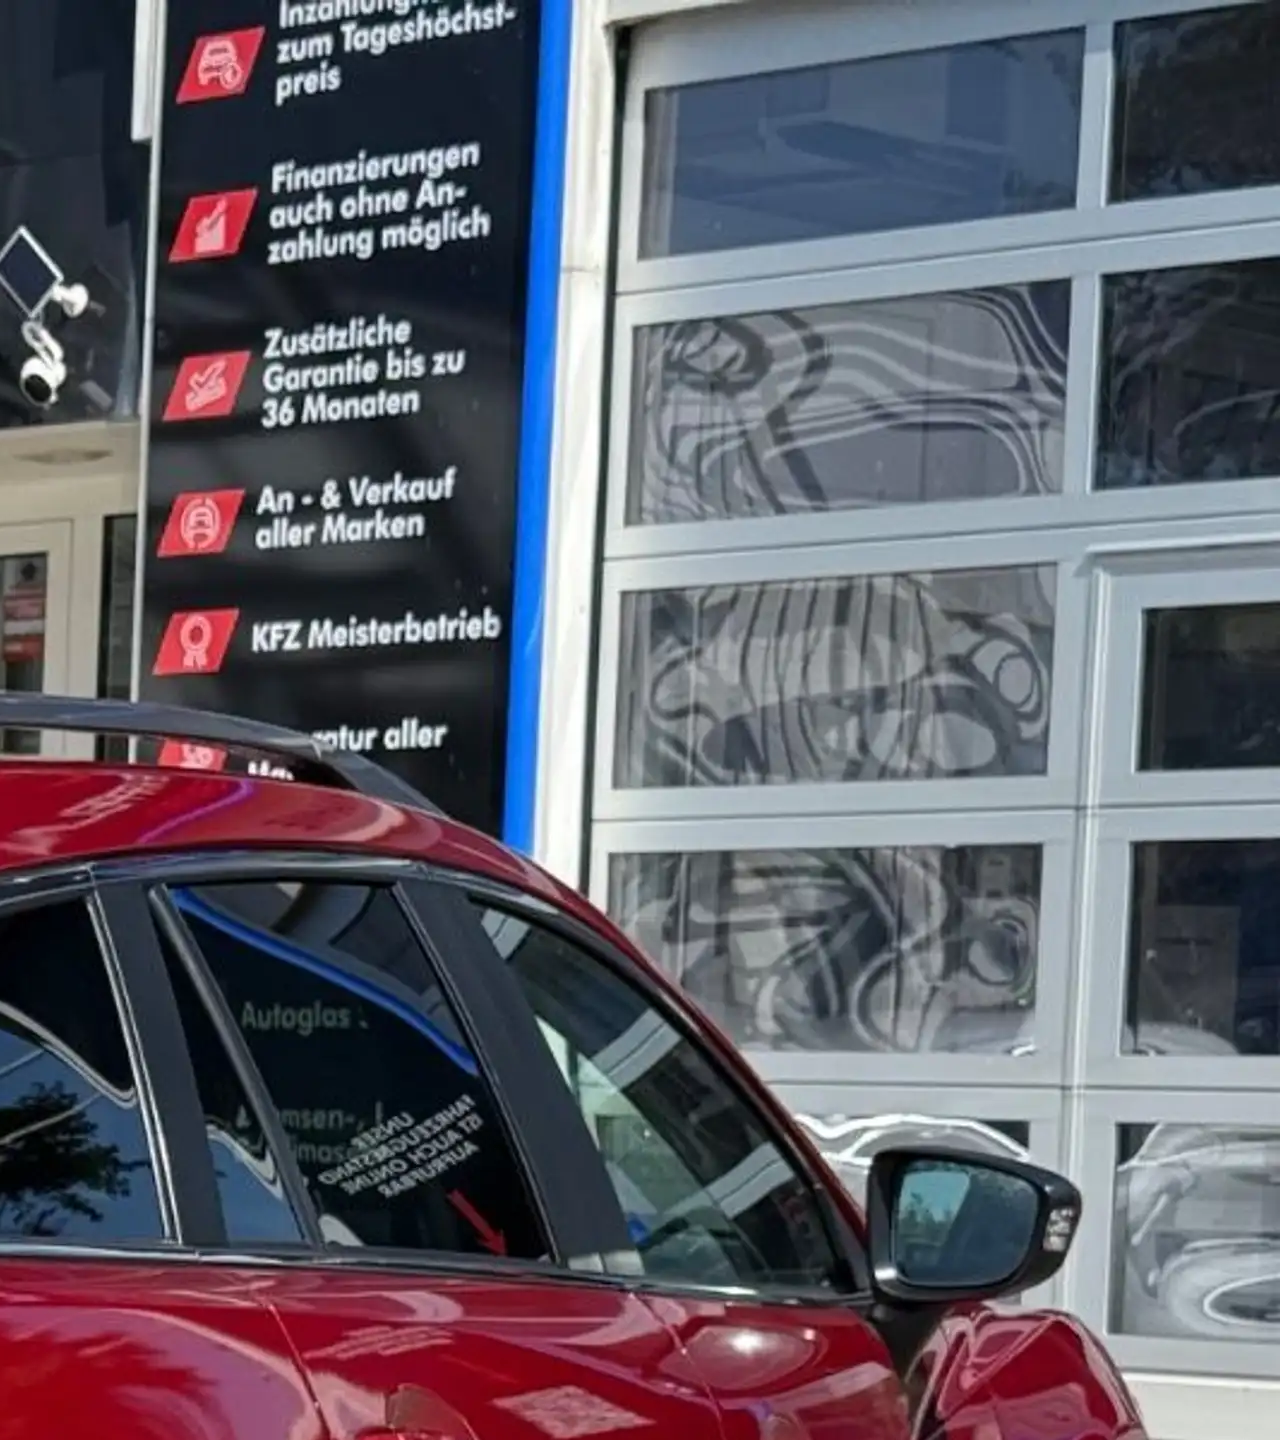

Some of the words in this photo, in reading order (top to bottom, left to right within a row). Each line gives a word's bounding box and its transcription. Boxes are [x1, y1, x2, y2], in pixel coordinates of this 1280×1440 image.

[276, 34, 333, 64] zum
[341, 0, 517, 55] Tageshöchst-
[276, 62, 341, 105] preis
[271, 142, 480, 194] Finanzierungen
[269, 191, 333, 229] auch
[340, 185, 409, 219] ohne
[415, 178, 467, 209] An-
[267, 226, 374, 265] zahlung
[381, 204, 490, 250] möglich
[263, 313, 412, 359] Zusätzliche
[263, 353, 379, 393] Garantie
[386, 347, 426, 380] bis
[431, 349, 467, 375] zu
[261, 396, 295, 428] 36
[301, 389, 421, 424] Monaten
[256, 485, 295, 515] An
[320, 480, 341, 510] &
[348, 465, 457, 506] Verkauf
[255, 516, 315, 549] aller
[321, 508, 425, 543] Marken
[252, 619, 302, 652] KFZ
[308, 605, 502, 649] Meisterbetrieb
[384, 716, 448, 750] aller
[241, 1000, 351, 1037] Autoglas
